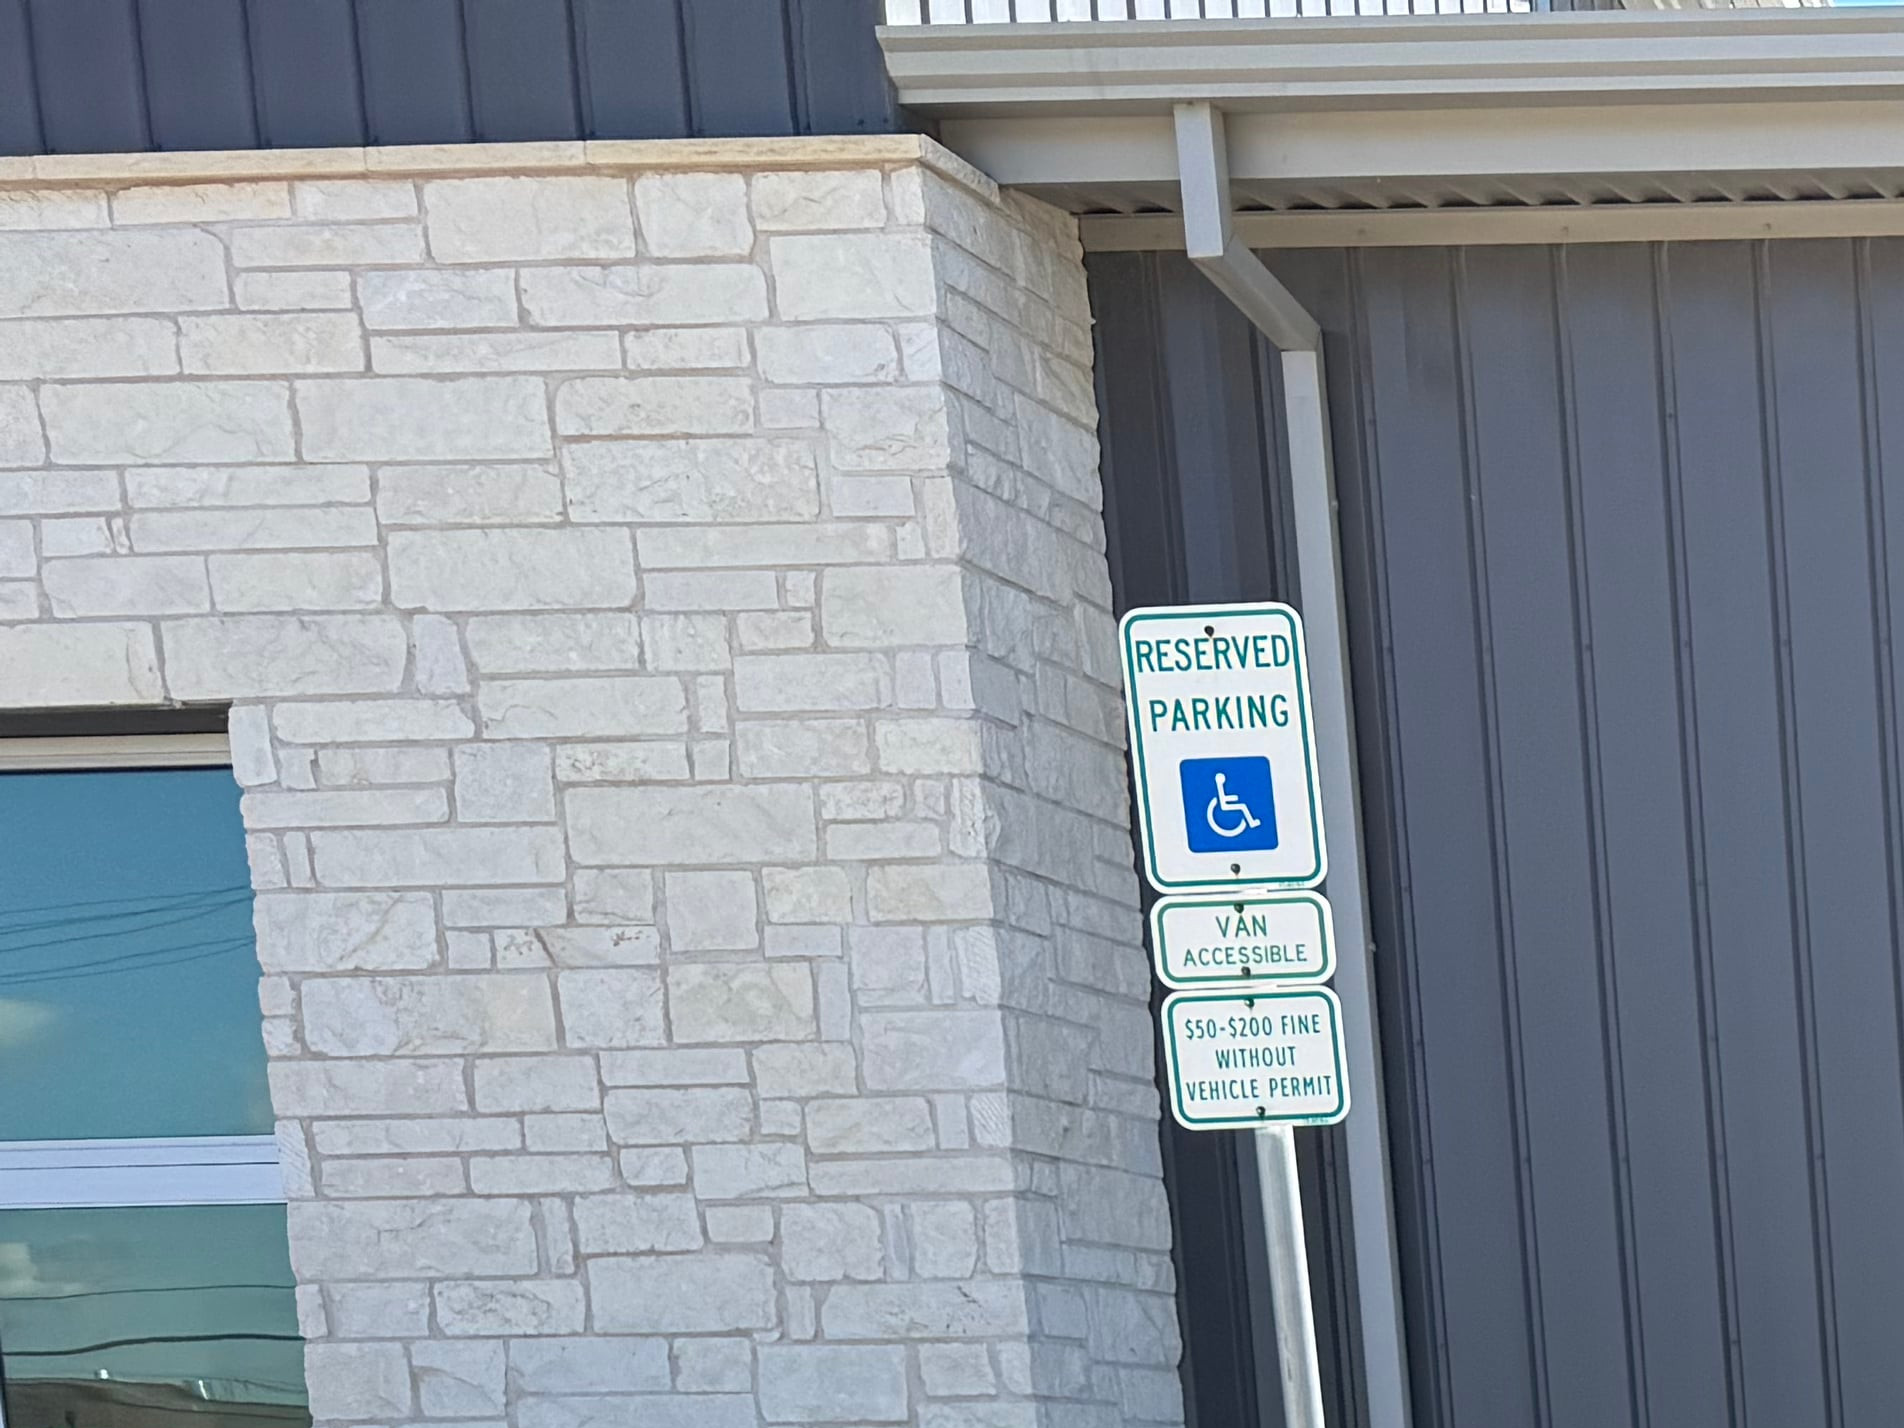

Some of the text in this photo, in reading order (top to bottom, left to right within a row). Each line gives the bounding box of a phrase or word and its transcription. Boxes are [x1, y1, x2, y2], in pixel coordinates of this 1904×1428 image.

[1136, 634, 1289, 672] RESERVED
[1150, 695, 1289, 731] PARKING
[1215, 915, 1266, 936] VAN
[1183, 943, 1307, 966] ACCESSIBLE
[1185, 1014, 1320, 1039] $50-$200 FINE
[1215, 1046, 1295, 1068] WITHOUT
[1185, 1075, 1331, 1101] VEHICLE PERMIT
